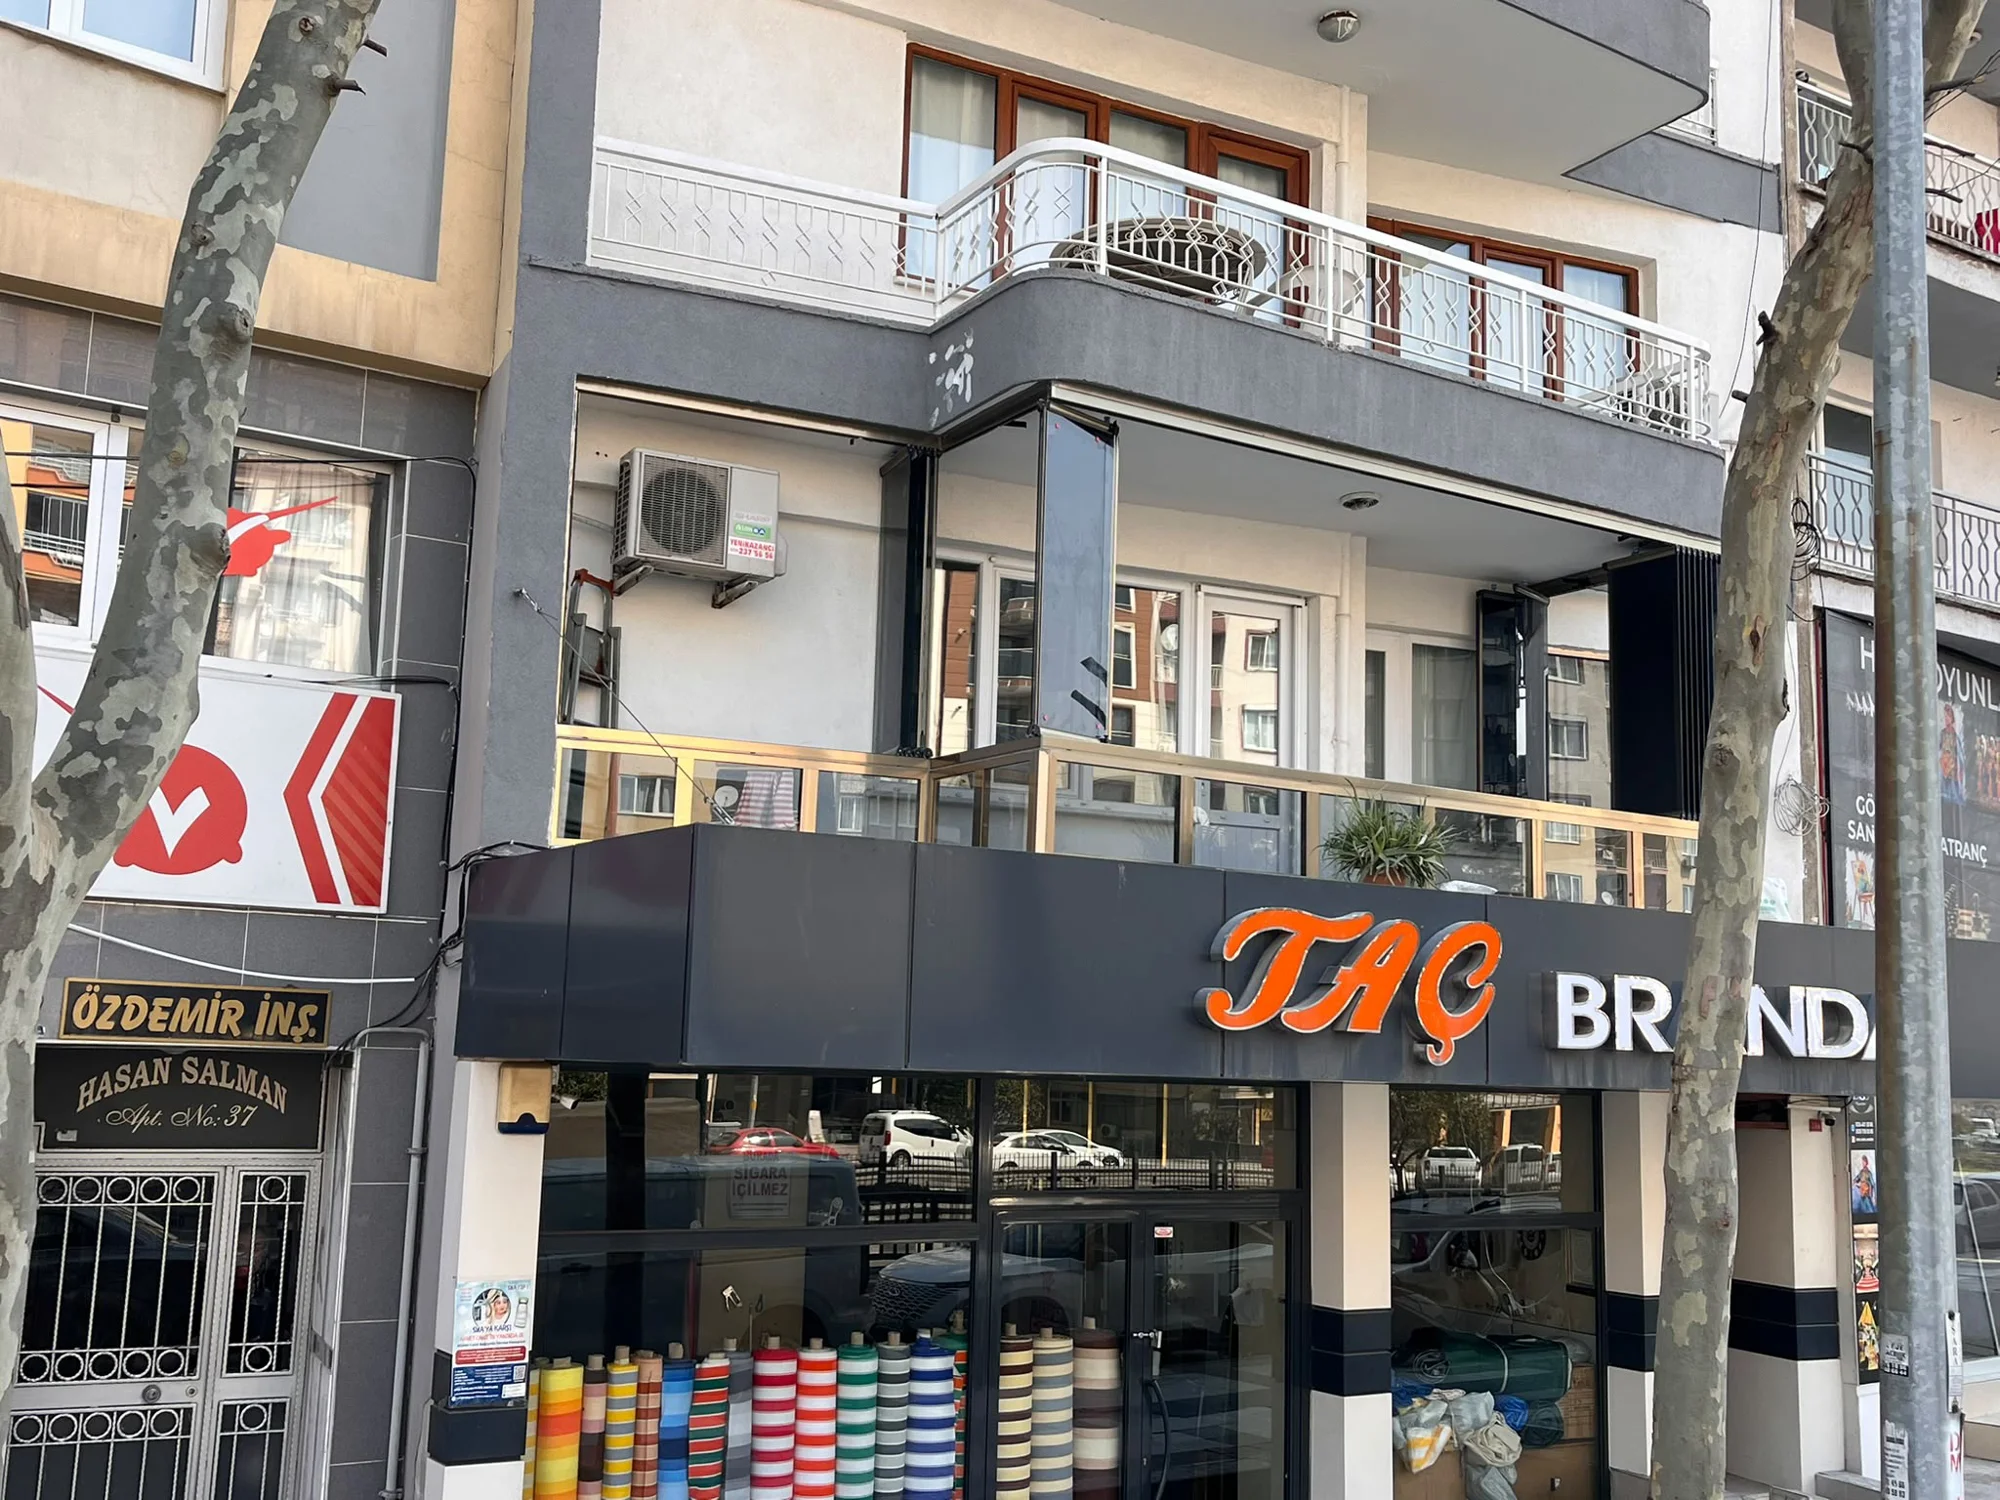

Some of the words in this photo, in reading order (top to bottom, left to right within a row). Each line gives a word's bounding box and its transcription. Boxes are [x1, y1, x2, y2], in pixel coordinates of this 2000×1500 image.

[1937, 662, 2000, 712] YUNL
[1940, 836, 1988, 868] ATRANÇ
[72, 984, 245, 1037] ÖZDEMİR
[254, 992, 319, 1043] İNŞ.
[1205, 907, 1502, 1066] TAÇ
[1555, 970, 1877, 1060] BRND
[76, 1057, 173, 1113] HASAN
[181, 1056, 288, 1115] SALMAN
[105, 1102, 163, 1134] Apt.
